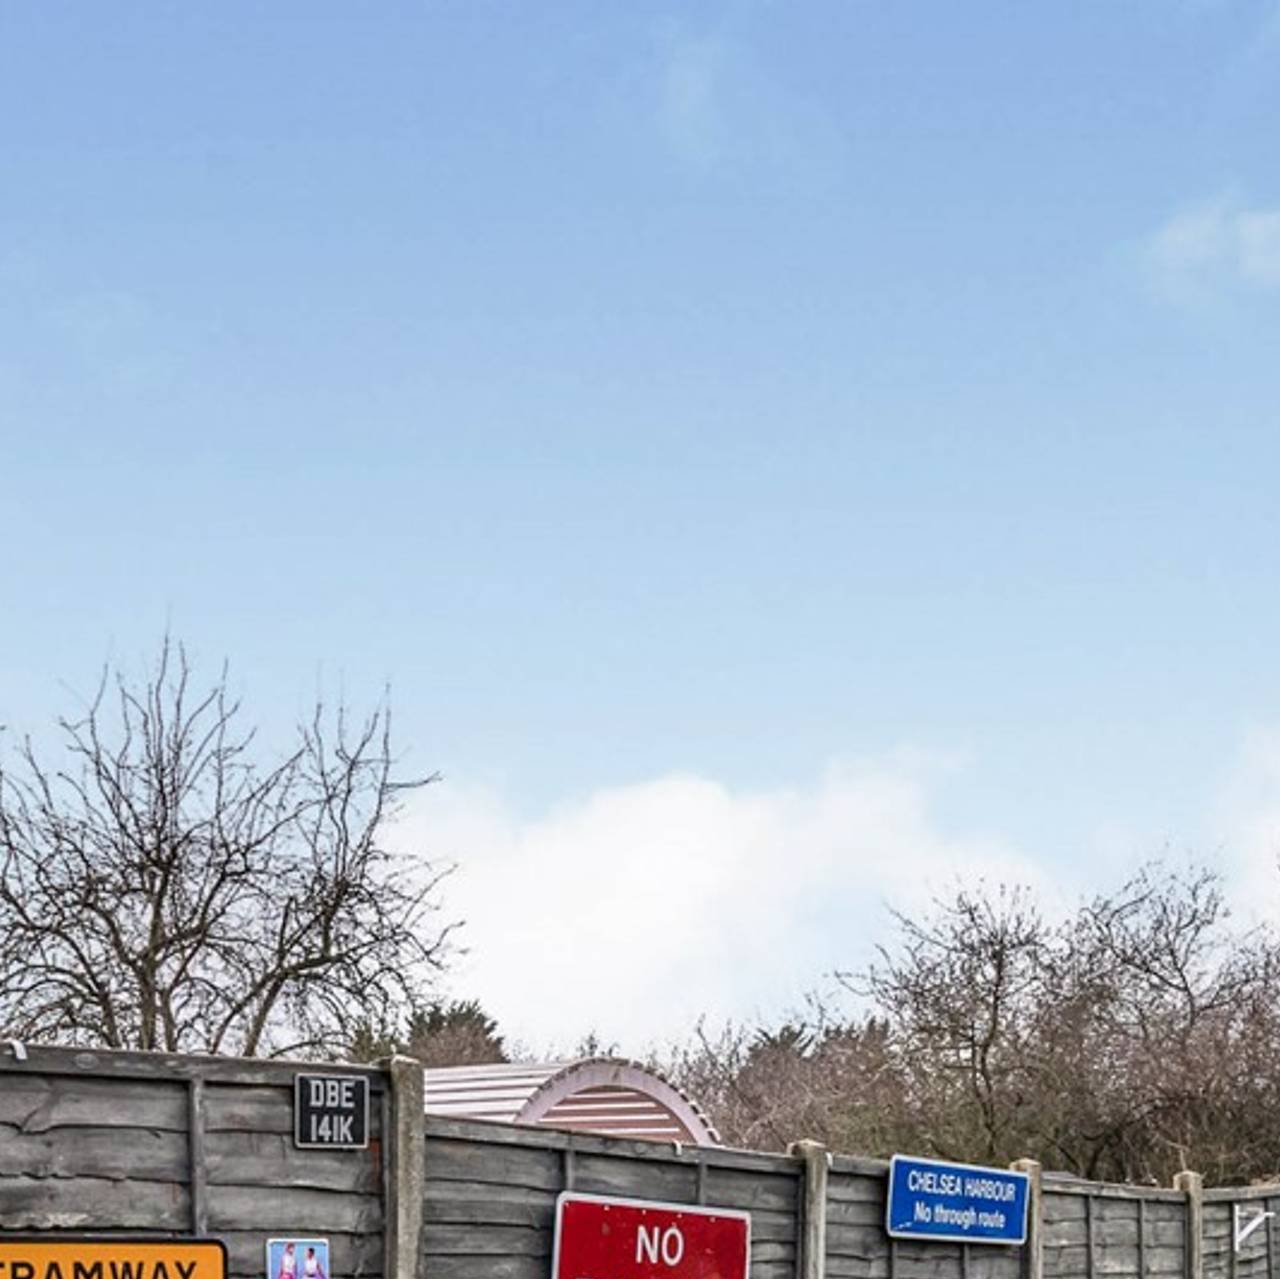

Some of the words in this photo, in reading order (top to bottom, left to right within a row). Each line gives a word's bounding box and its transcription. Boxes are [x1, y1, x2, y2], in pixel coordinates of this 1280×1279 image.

[309, 1079, 355, 1108] DBE
[908, 1170, 962, 1196] CHELSEA
[964, 1177, 1016, 1202] HARBOUR
[914, 1200, 932, 1222] No
[934, 1202, 977, 1230] through
[978, 1209, 1006, 1229] route
[635, 1225, 684, 1267] NO
